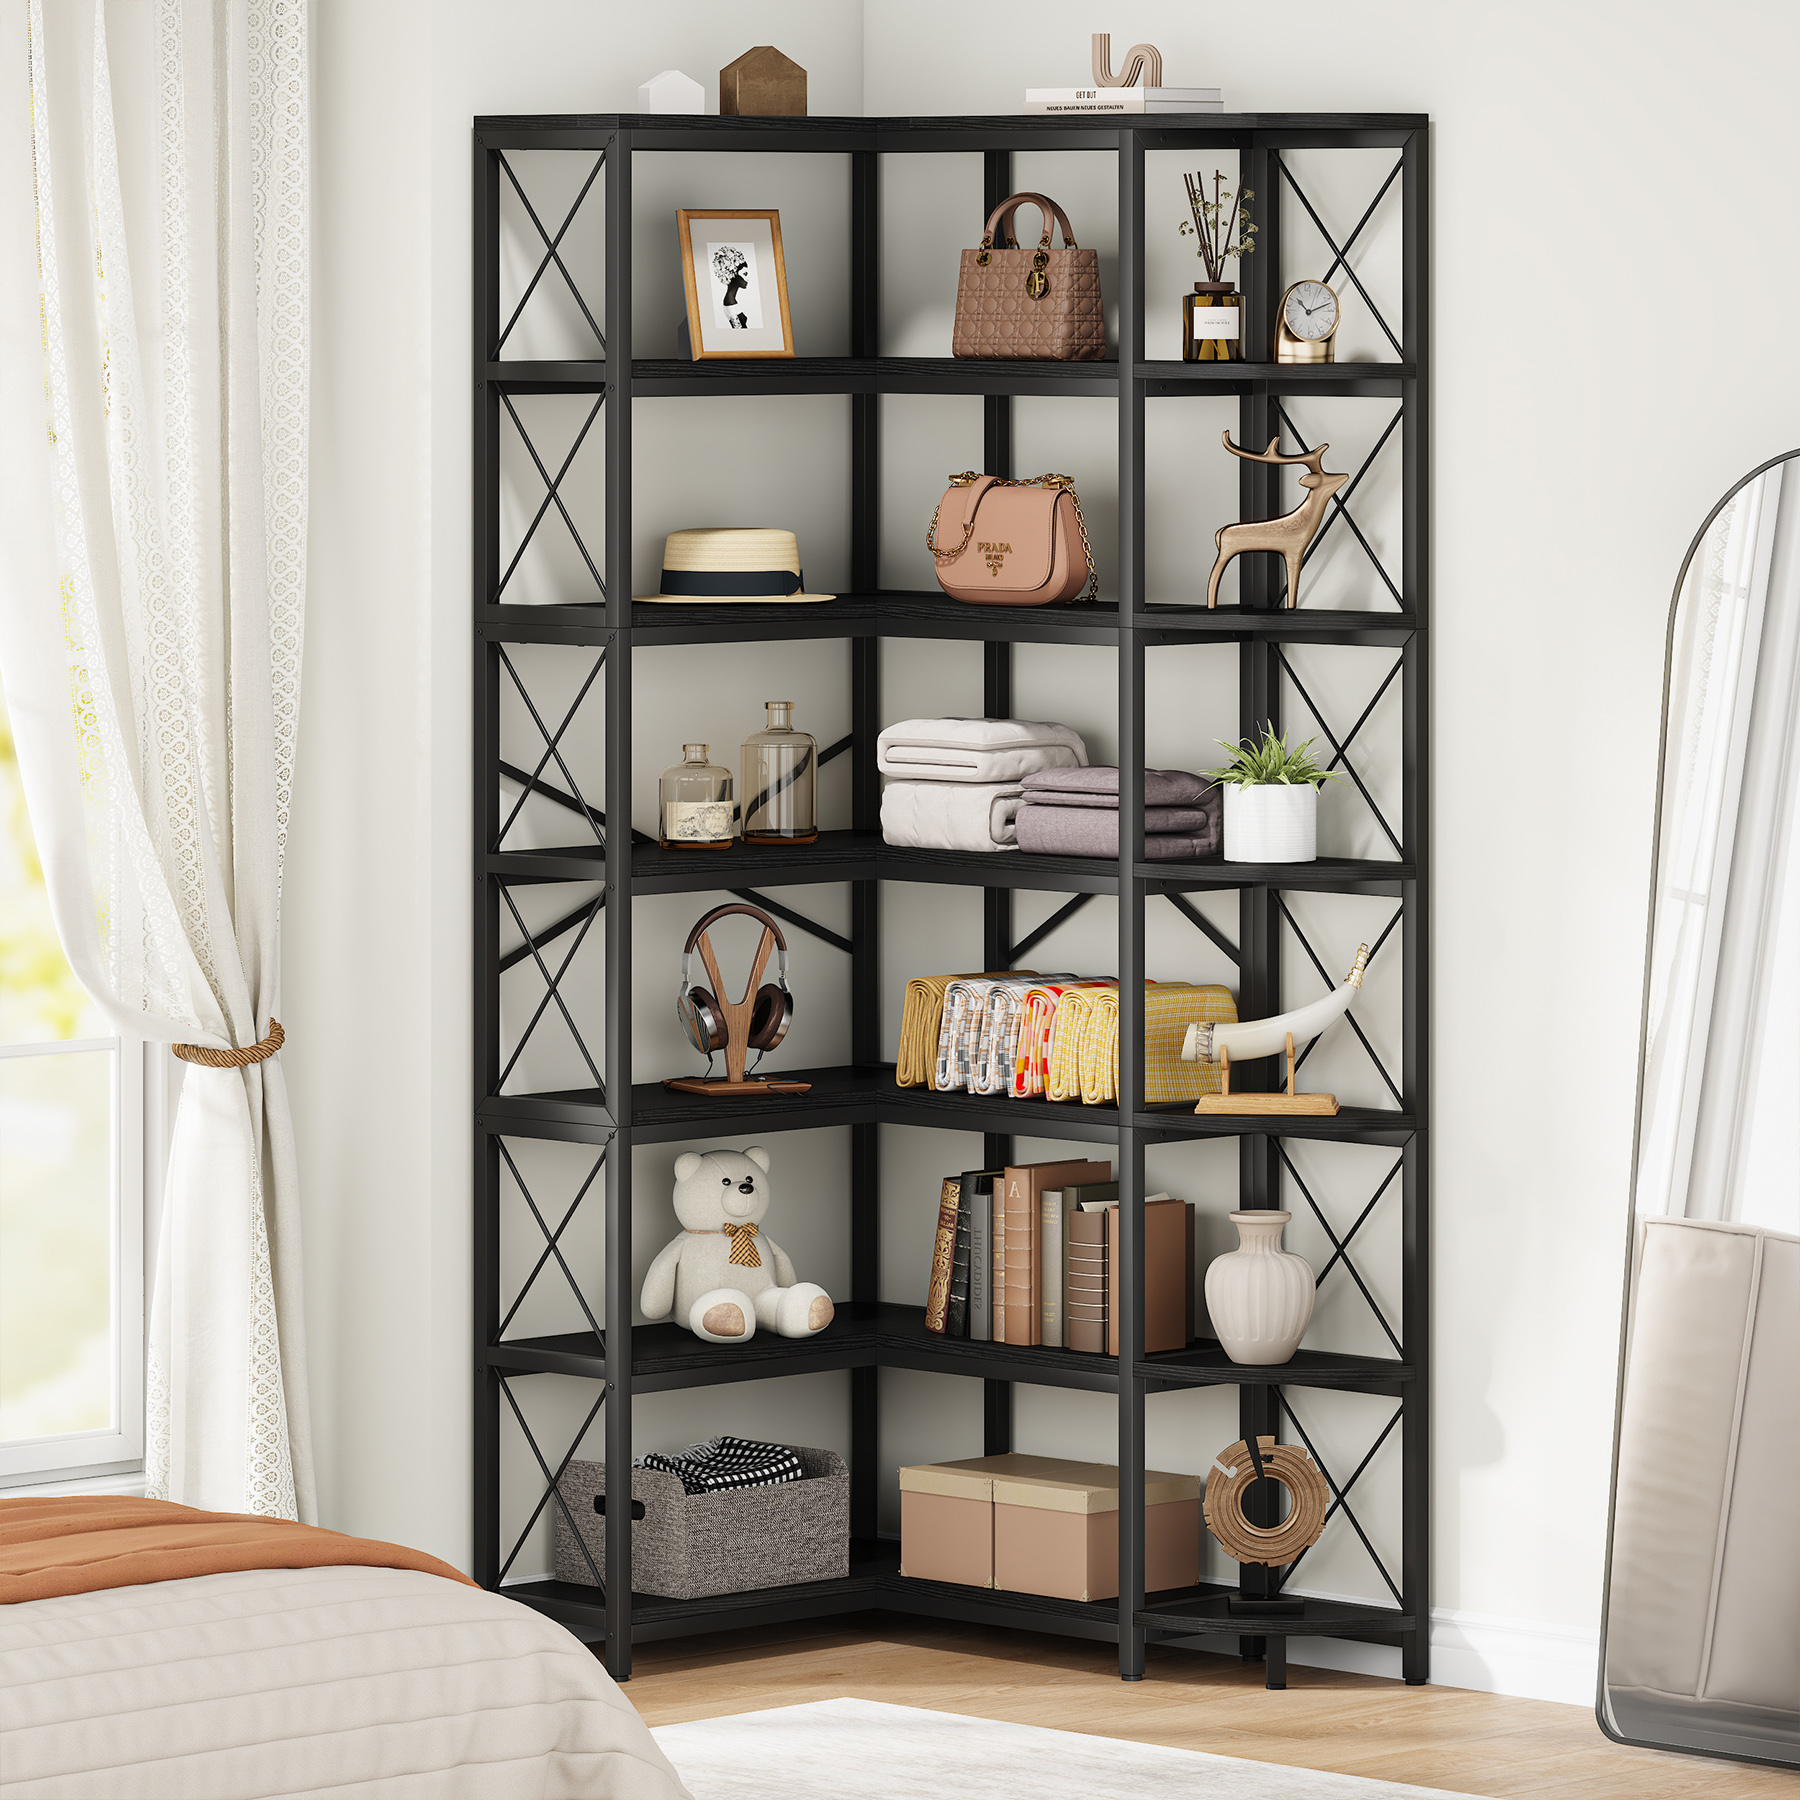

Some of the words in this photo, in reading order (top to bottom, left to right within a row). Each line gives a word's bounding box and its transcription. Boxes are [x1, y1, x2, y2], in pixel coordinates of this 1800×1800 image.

[1076, 90, 1085, 99] GET
[977, 541, 1013, 554] PRADA
[1009, 1181, 1021, 1198] A
